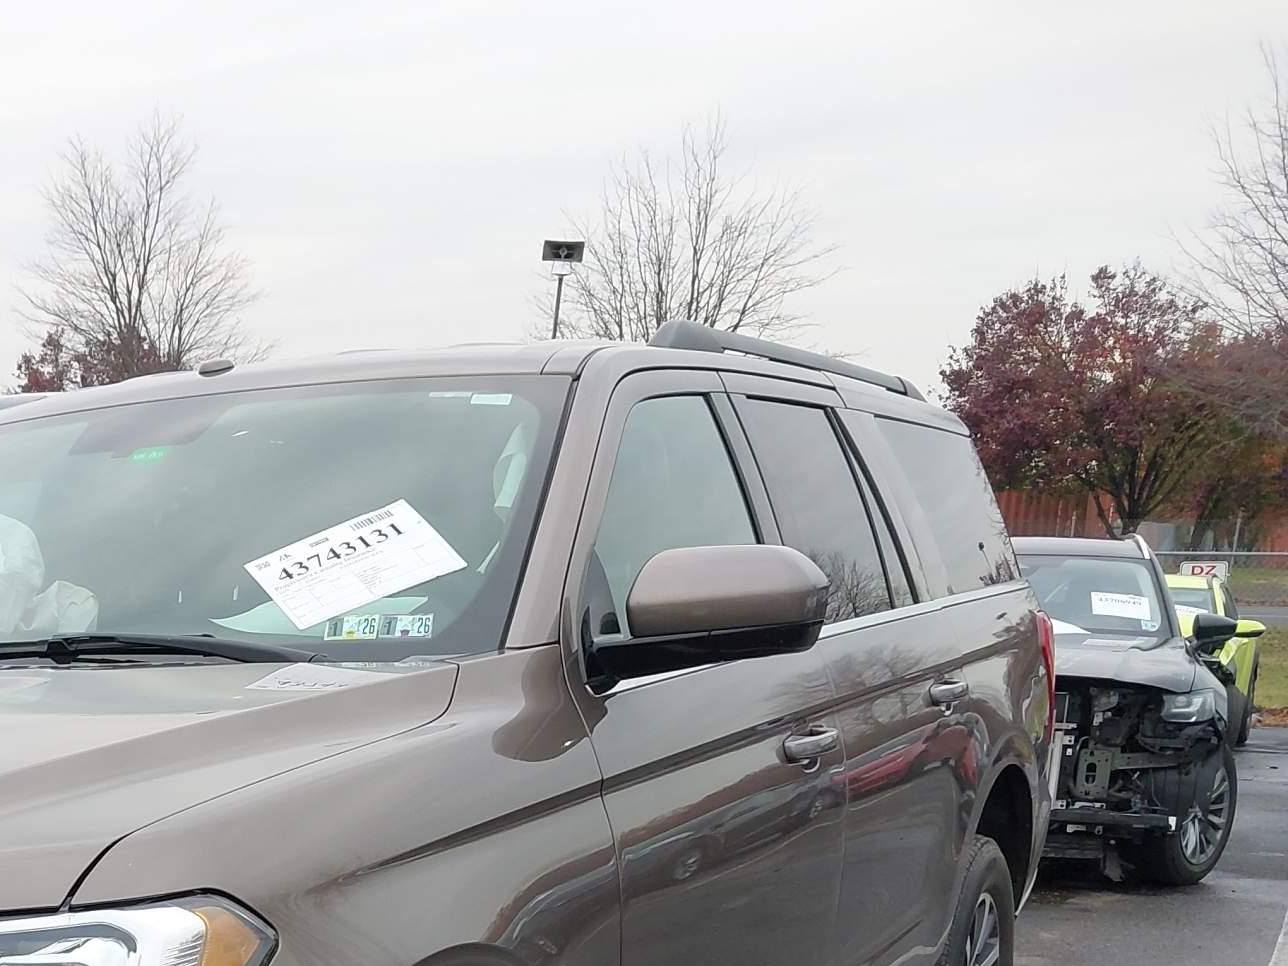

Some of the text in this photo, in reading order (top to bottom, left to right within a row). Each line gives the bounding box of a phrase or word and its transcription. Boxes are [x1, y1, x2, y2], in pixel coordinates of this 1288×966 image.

[278, 523, 405, 581] 43743131
[1192, 565, 1217, 576] DZ
[362, 617, 376, 635] 26
[417, 617, 431, 634] 26
